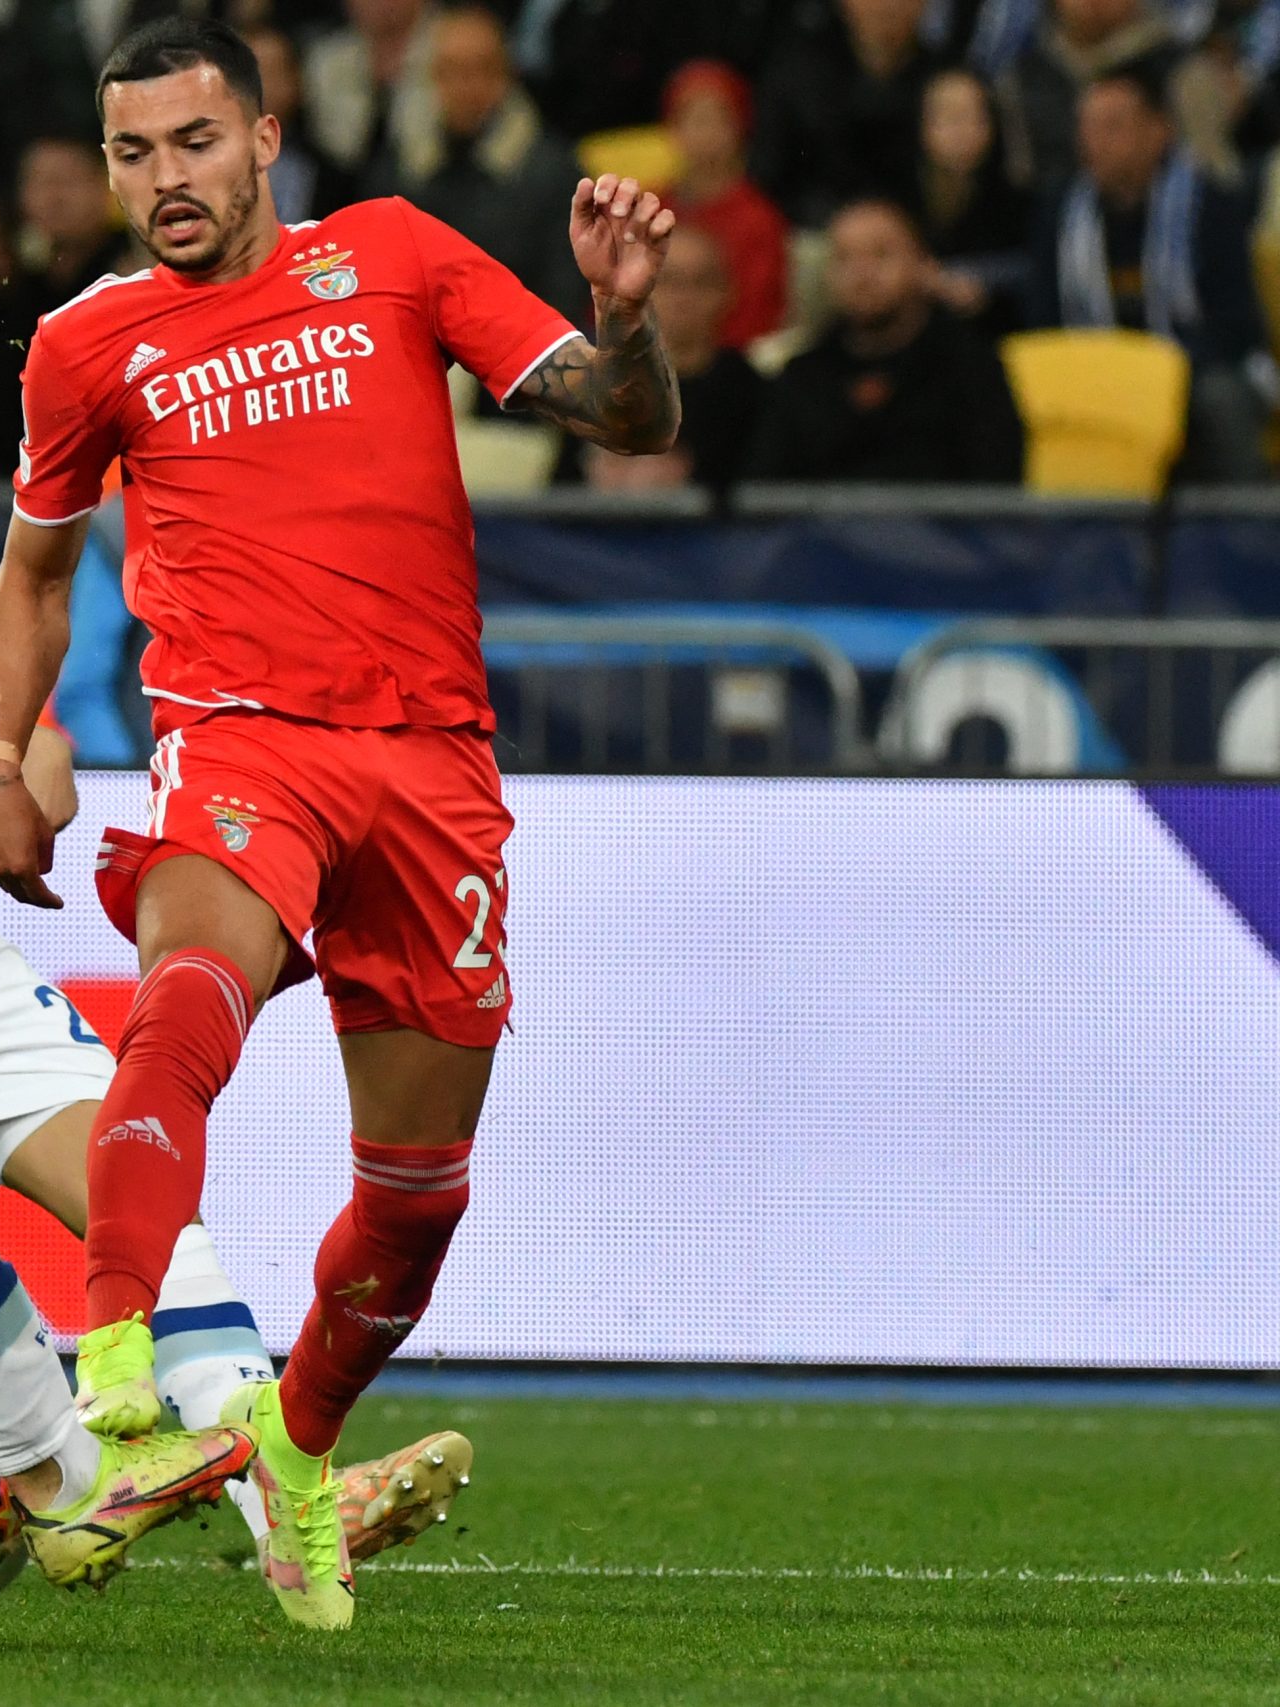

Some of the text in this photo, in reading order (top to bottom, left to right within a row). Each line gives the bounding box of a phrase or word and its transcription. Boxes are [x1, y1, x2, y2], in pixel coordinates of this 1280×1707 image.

[124, 348, 168, 384] adidas
[141, 323, 375, 422] Emirates
[188, 367, 352, 445] FLY BETTER
[452, 865, 507, 969] 2
[97, 1126, 181, 1161] adidas
